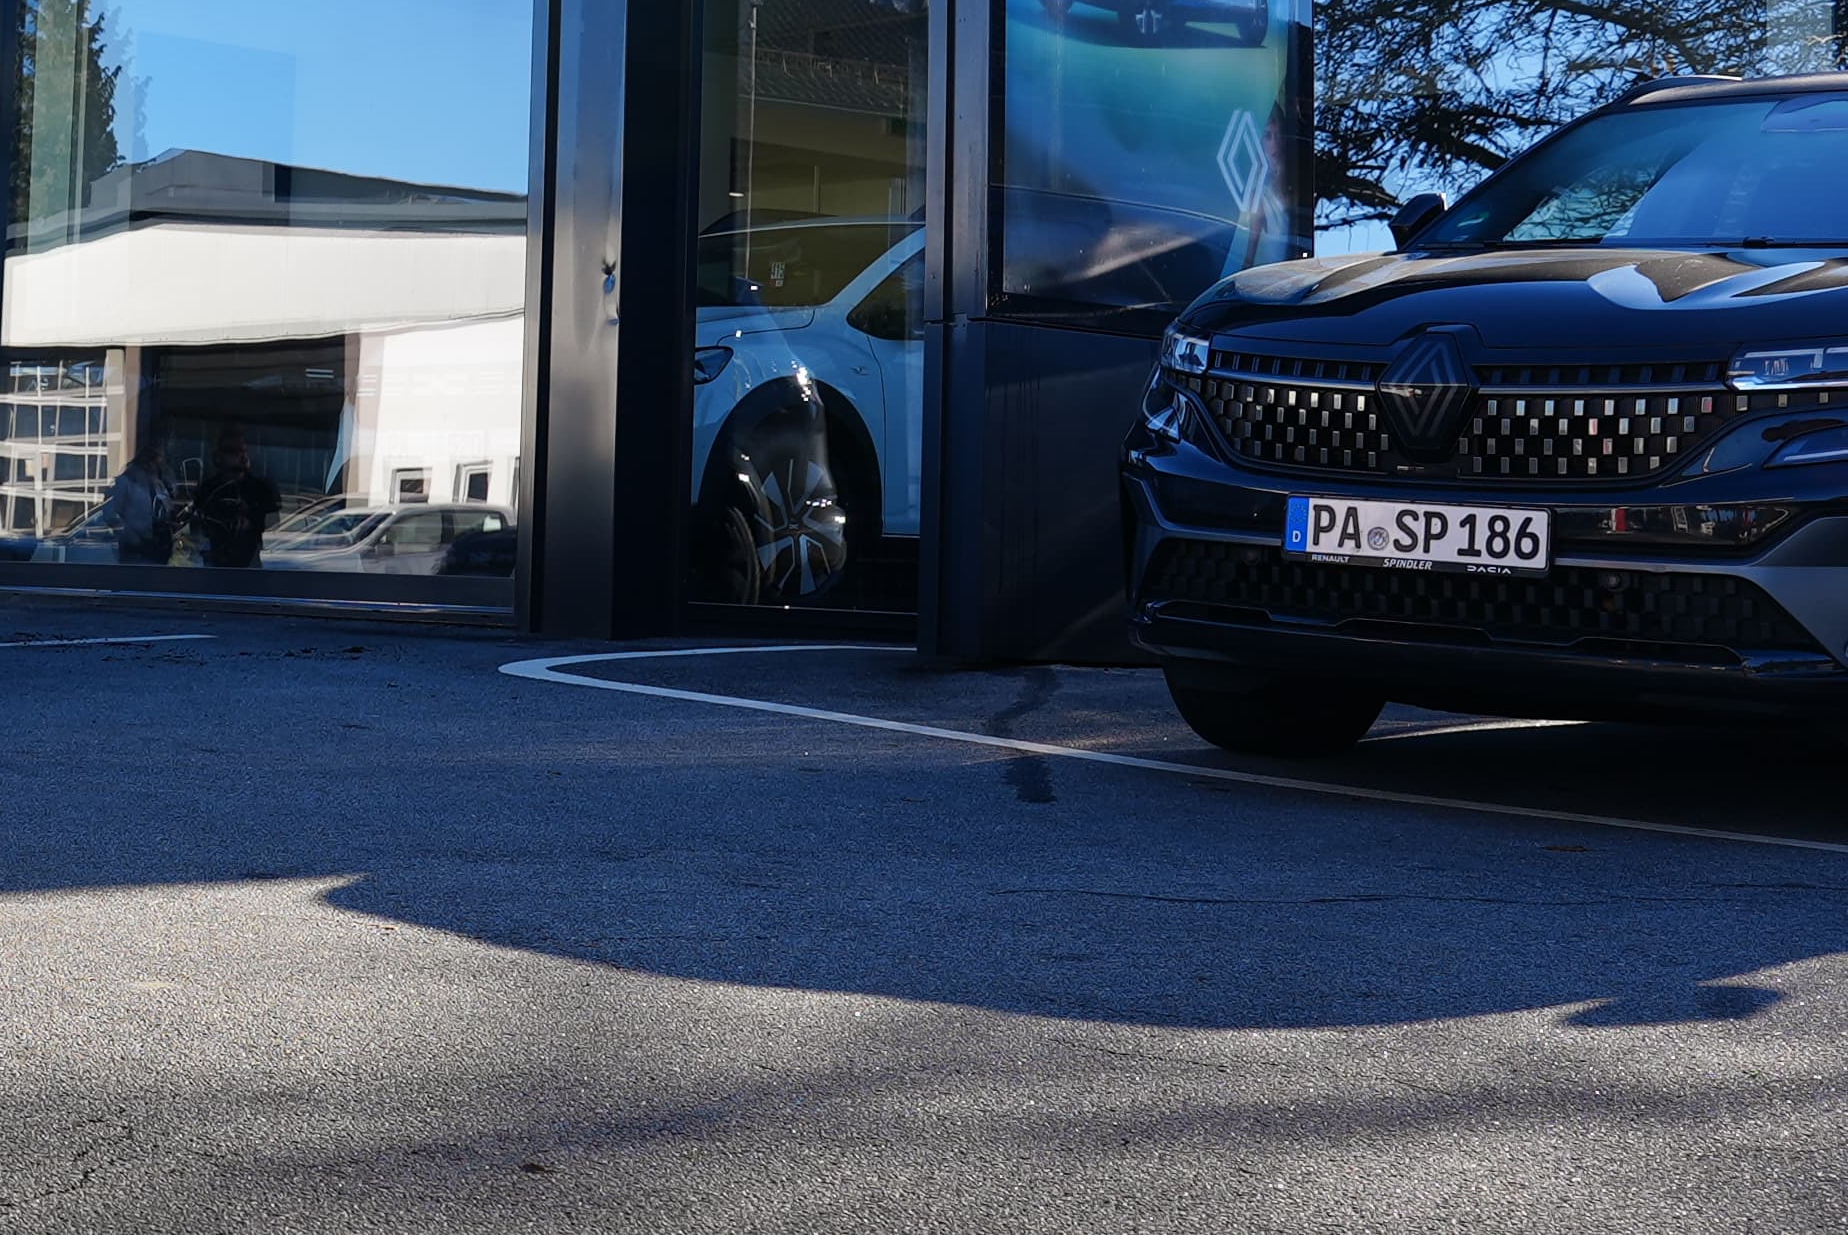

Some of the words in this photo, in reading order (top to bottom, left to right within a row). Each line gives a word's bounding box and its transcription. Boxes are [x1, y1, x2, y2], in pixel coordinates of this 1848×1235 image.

[1291, 530, 1301, 543] D
[1312, 504, 1362, 549] PA
[1393, 509, 1449, 554] SP
[1457, 513, 1540, 561] 186
[1311, 554, 1350, 564] RENAULT
[1383, 558, 1433, 571] SPINDLER
[1467, 565, 1512, 575] DACIA
